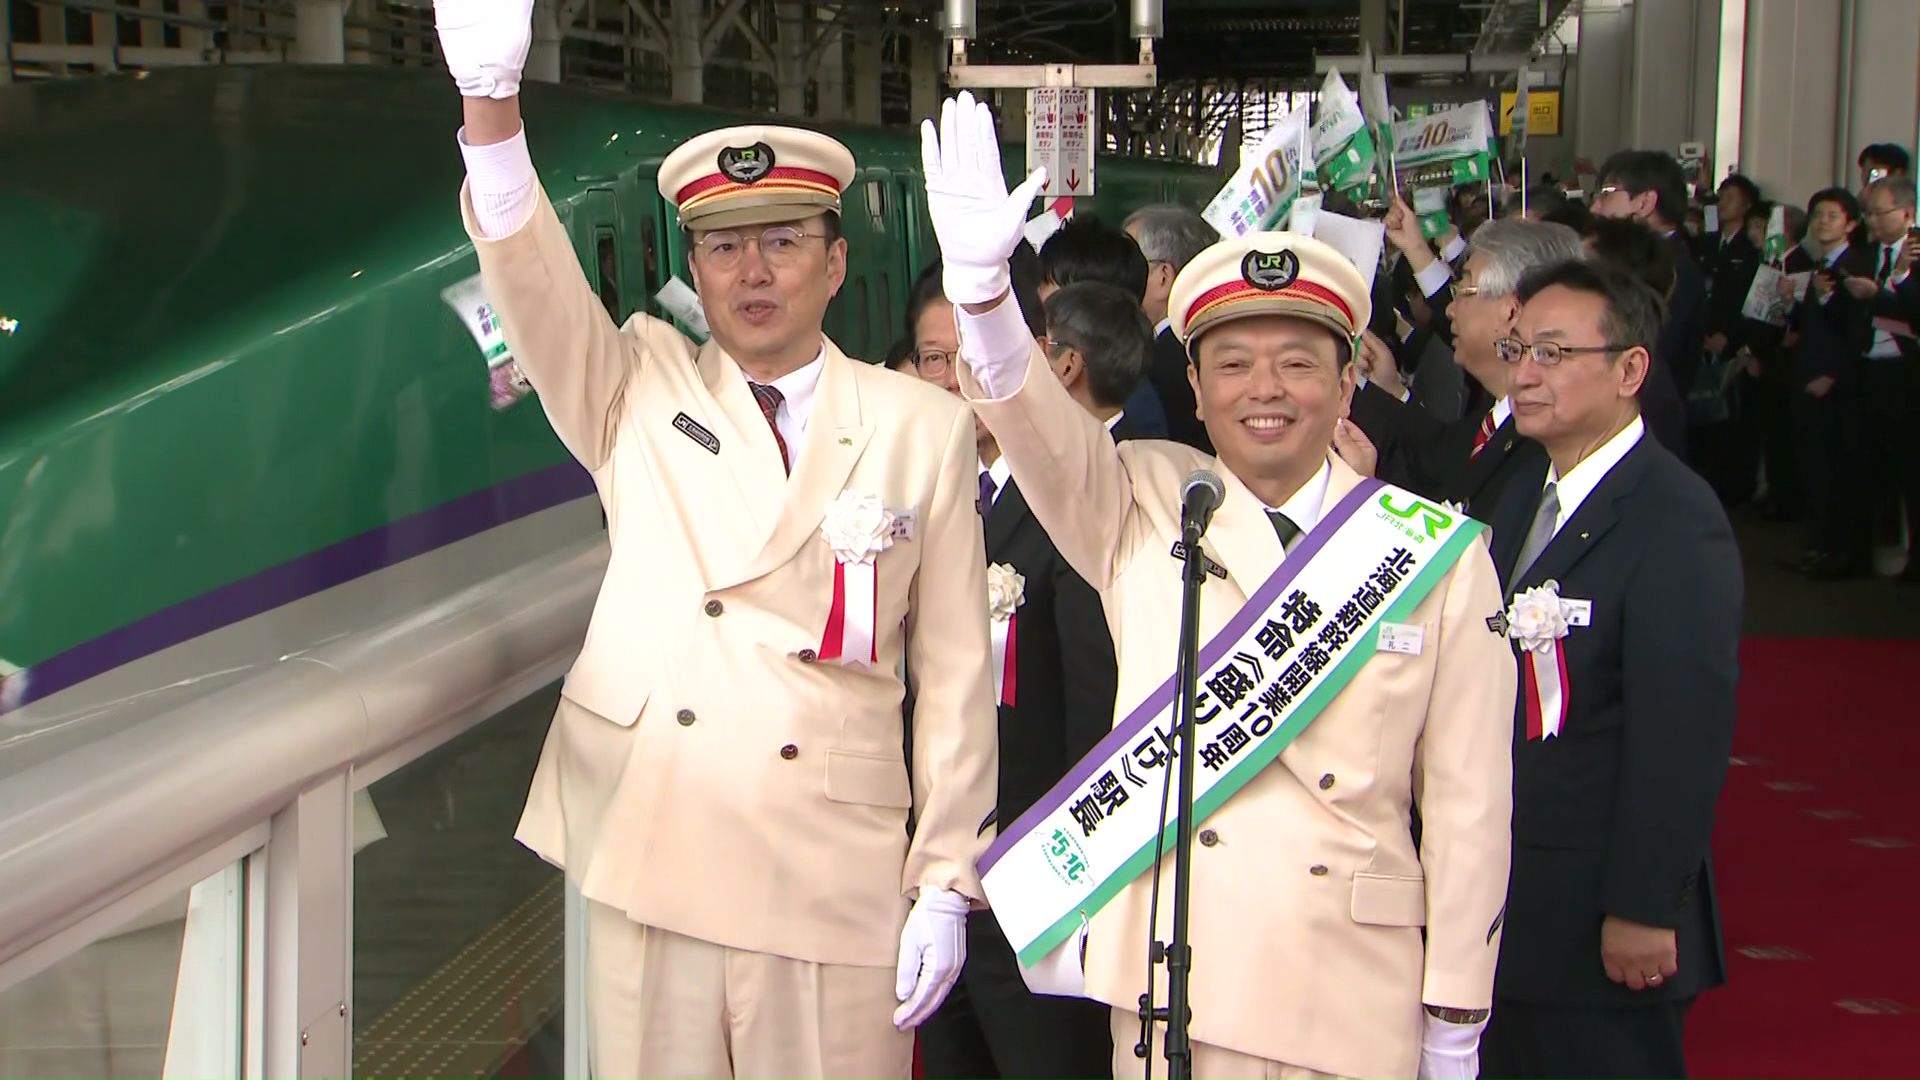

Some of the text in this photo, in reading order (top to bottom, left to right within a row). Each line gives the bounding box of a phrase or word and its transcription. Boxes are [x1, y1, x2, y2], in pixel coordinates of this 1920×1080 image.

[1037, 95, 1053, 104] STOP
[1064, 95, 1084, 104] STOP
[1250, 149, 1288, 205] 10
[1259, 255, 1282, 269] JR
[1379, 493, 1452, 540] JR
